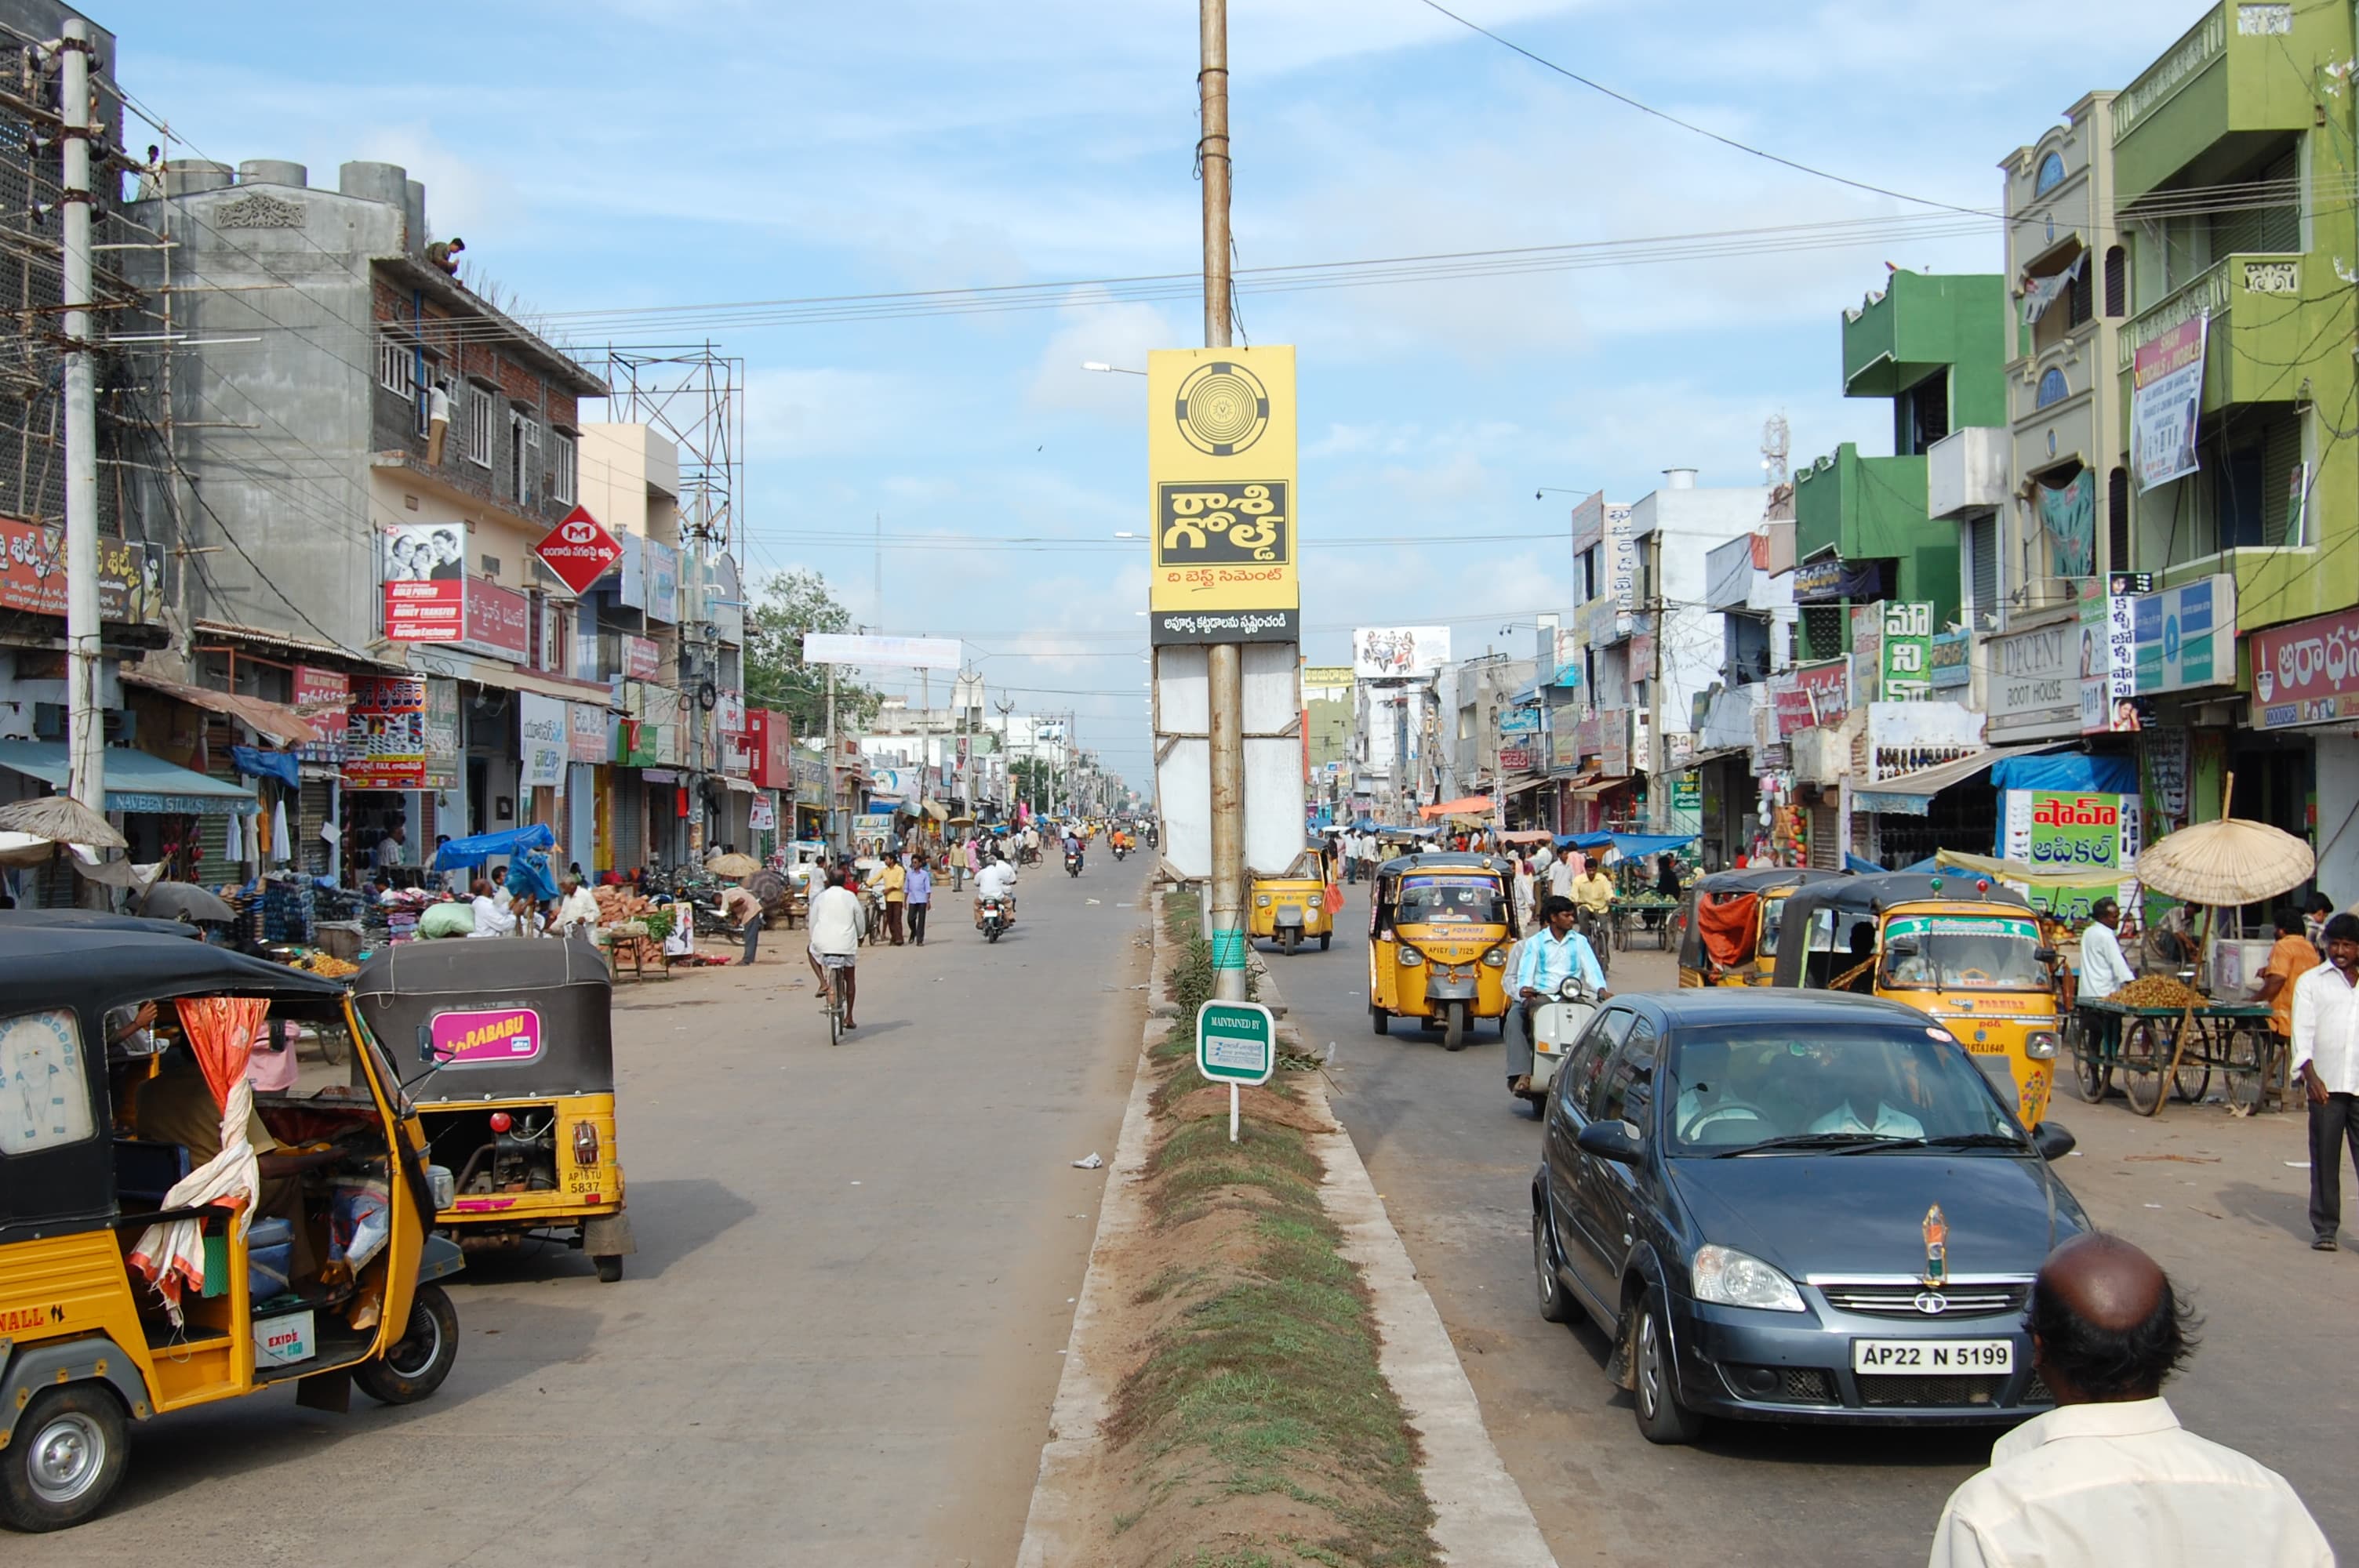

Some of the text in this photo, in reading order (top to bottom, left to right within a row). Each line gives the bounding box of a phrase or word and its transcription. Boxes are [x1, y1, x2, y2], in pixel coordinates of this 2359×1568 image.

[1171, 485, 1274, 515] రాశి
[1163, 511, 1285, 561] గోల్డ్
[1167, 568, 1282, 587] ది బెస్ట్ సిమెంట్
[1164, 613, 1286, 634] అపూర్వ కట్టడాలను సృష్టించండి
[2005, 629, 2065, 674] DECENT
[2008, 684, 2030, 706] BOOT
[2034, 681, 2062, 702] HOUSE
[117, 794, 163, 811] NAVEEN
[165, 797, 205, 812] SILKS
[2034, 797, 2117, 828] షాహ్
[1211, 1016, 1261, 1030] MAINTAINED BY
[571, 1182, 599, 1193] 5837
[268, 1331, 299, 1348] EXIDE
[1863, 1347, 2008, 1366] AP22 N 5199
